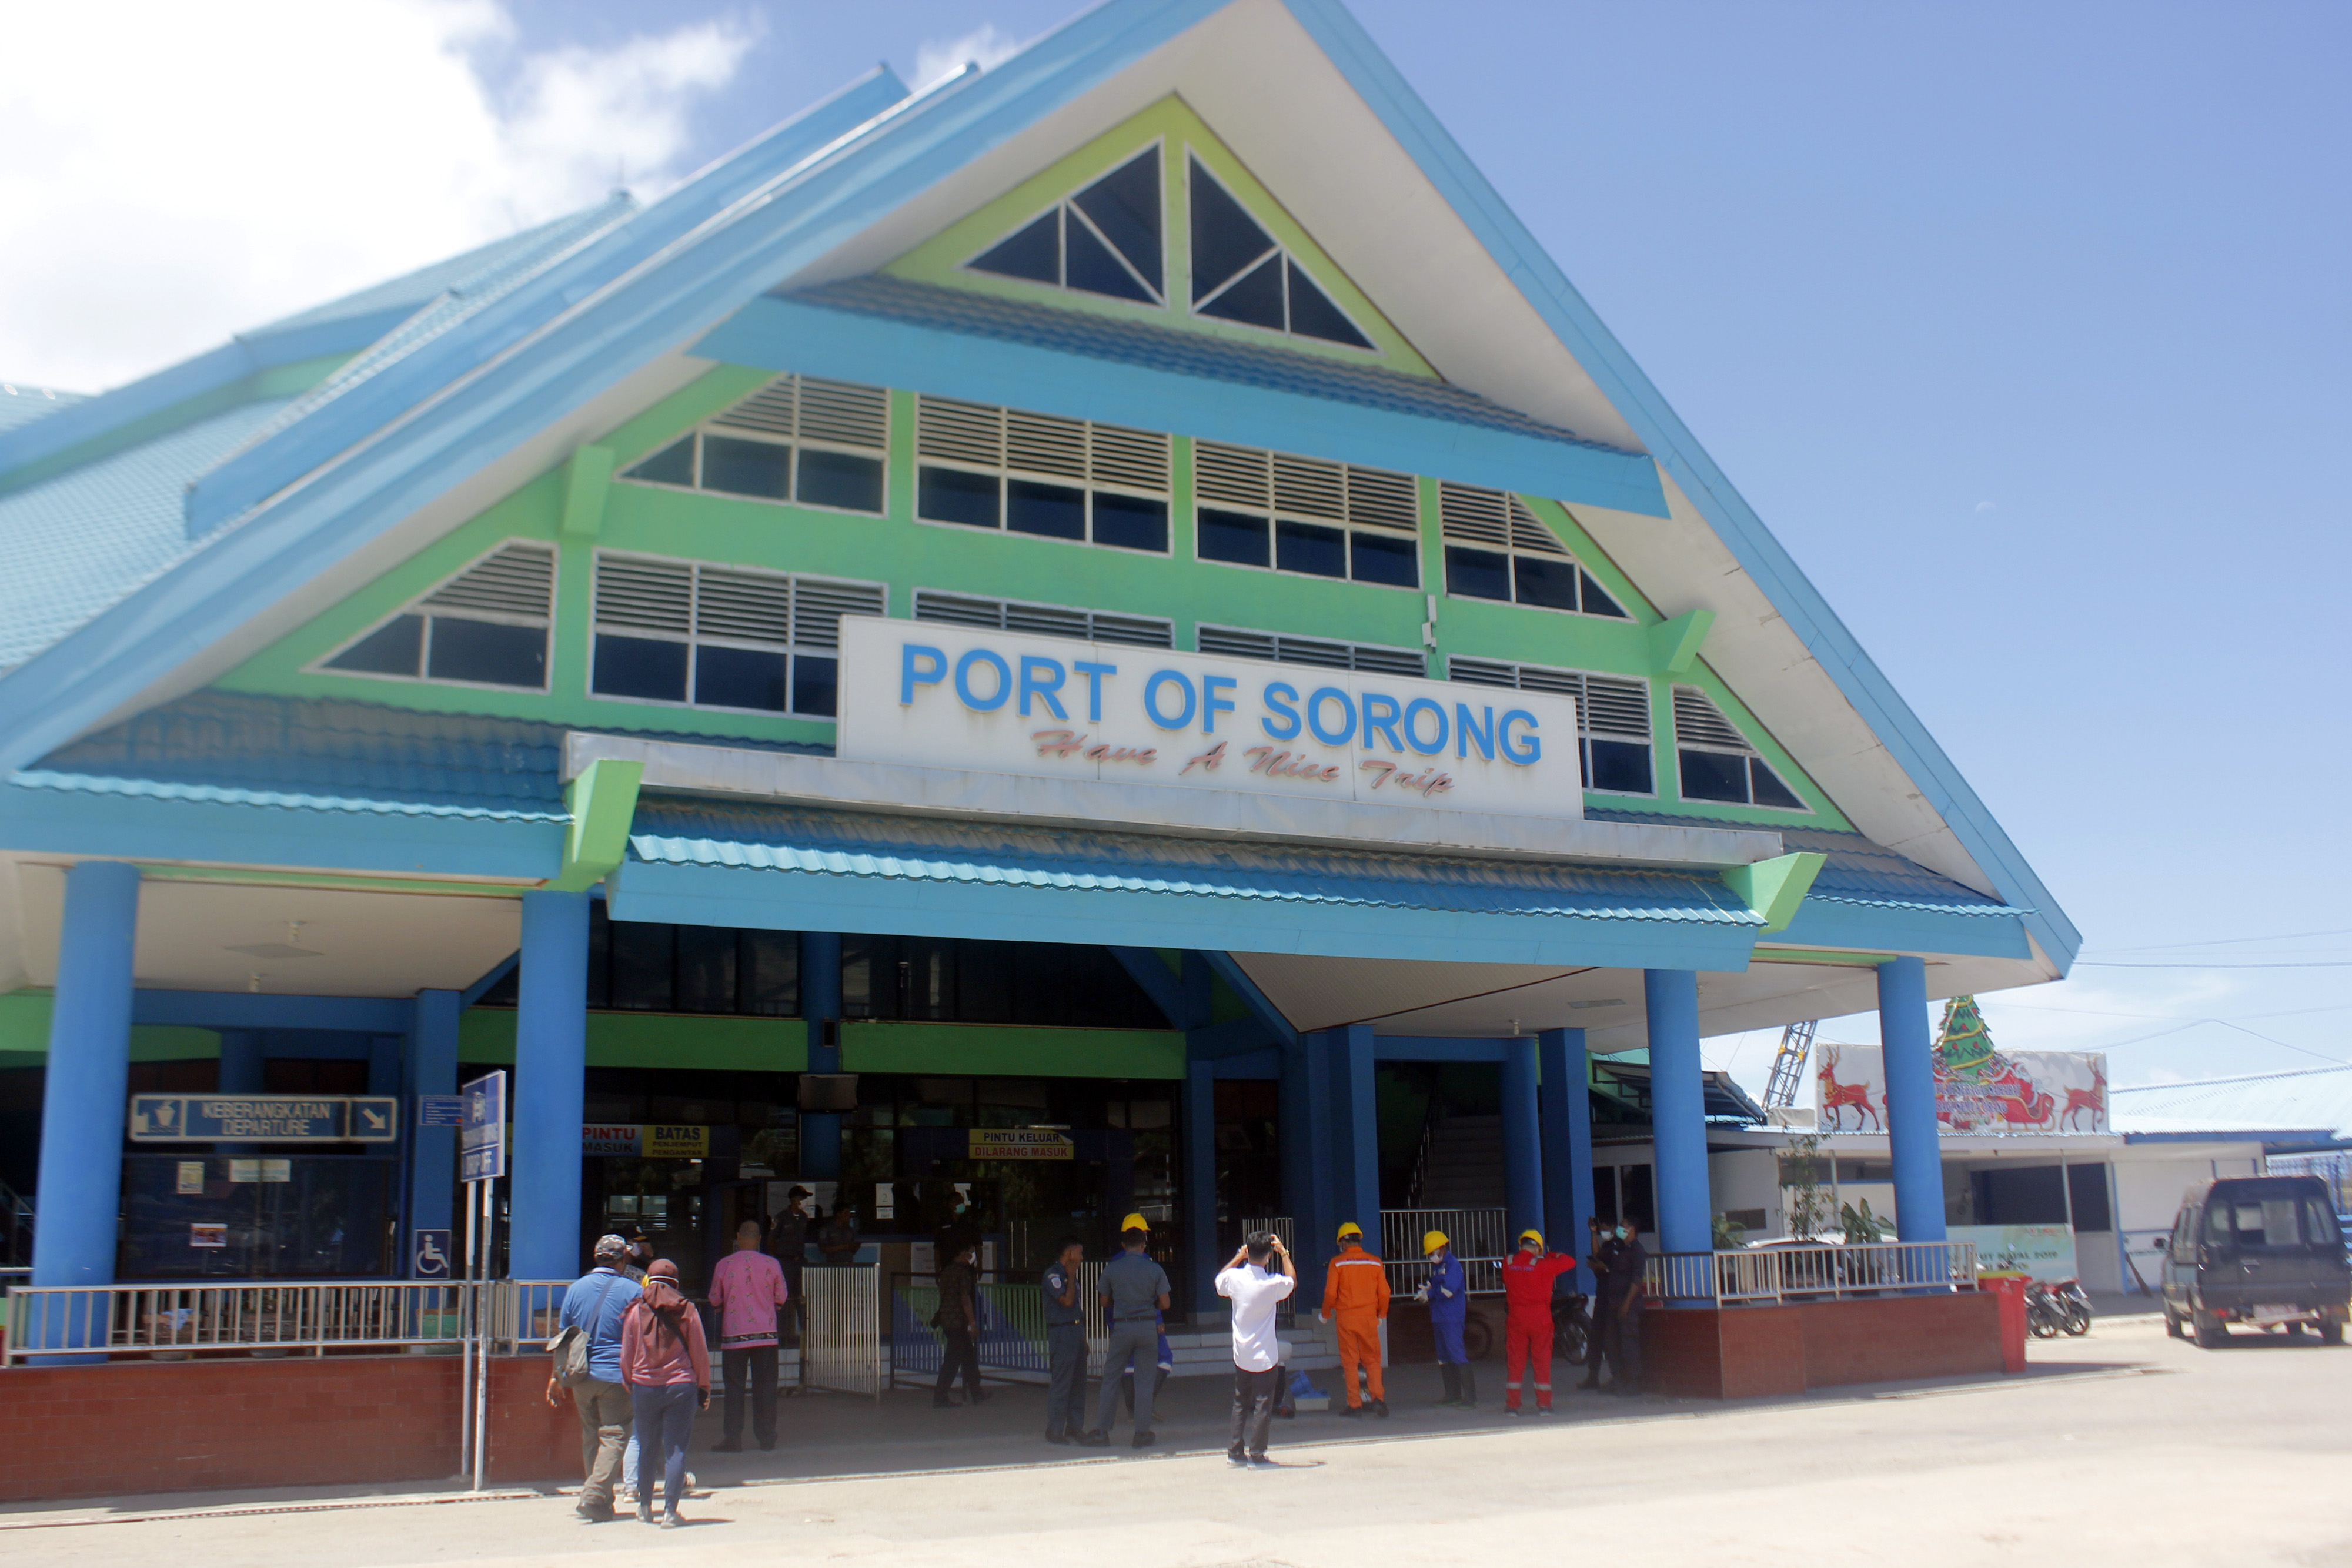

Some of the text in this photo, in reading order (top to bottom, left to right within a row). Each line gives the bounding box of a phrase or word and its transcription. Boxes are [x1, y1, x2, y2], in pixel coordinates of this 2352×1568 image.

[900, 643, 1542, 768] PORT OF SORONG
[1031, 729, 1158, 765] Have
[1178, 741, 1230, 777] A
[1359, 758, 1456, 798] Trip
[202, 1102, 330, 1119] KEBERANGKATAN
[222, 1119, 310, 1135] DEPARTURE
[583, 1126, 636, 1140] PINTU
[655, 1126, 700, 1141] BATAS
[984, 1132, 1060, 1142] PINTU KELUAR
[583, 1142, 633, 1153] MASUK
[975, 1147, 1068, 1157] DILARANG MASUK
